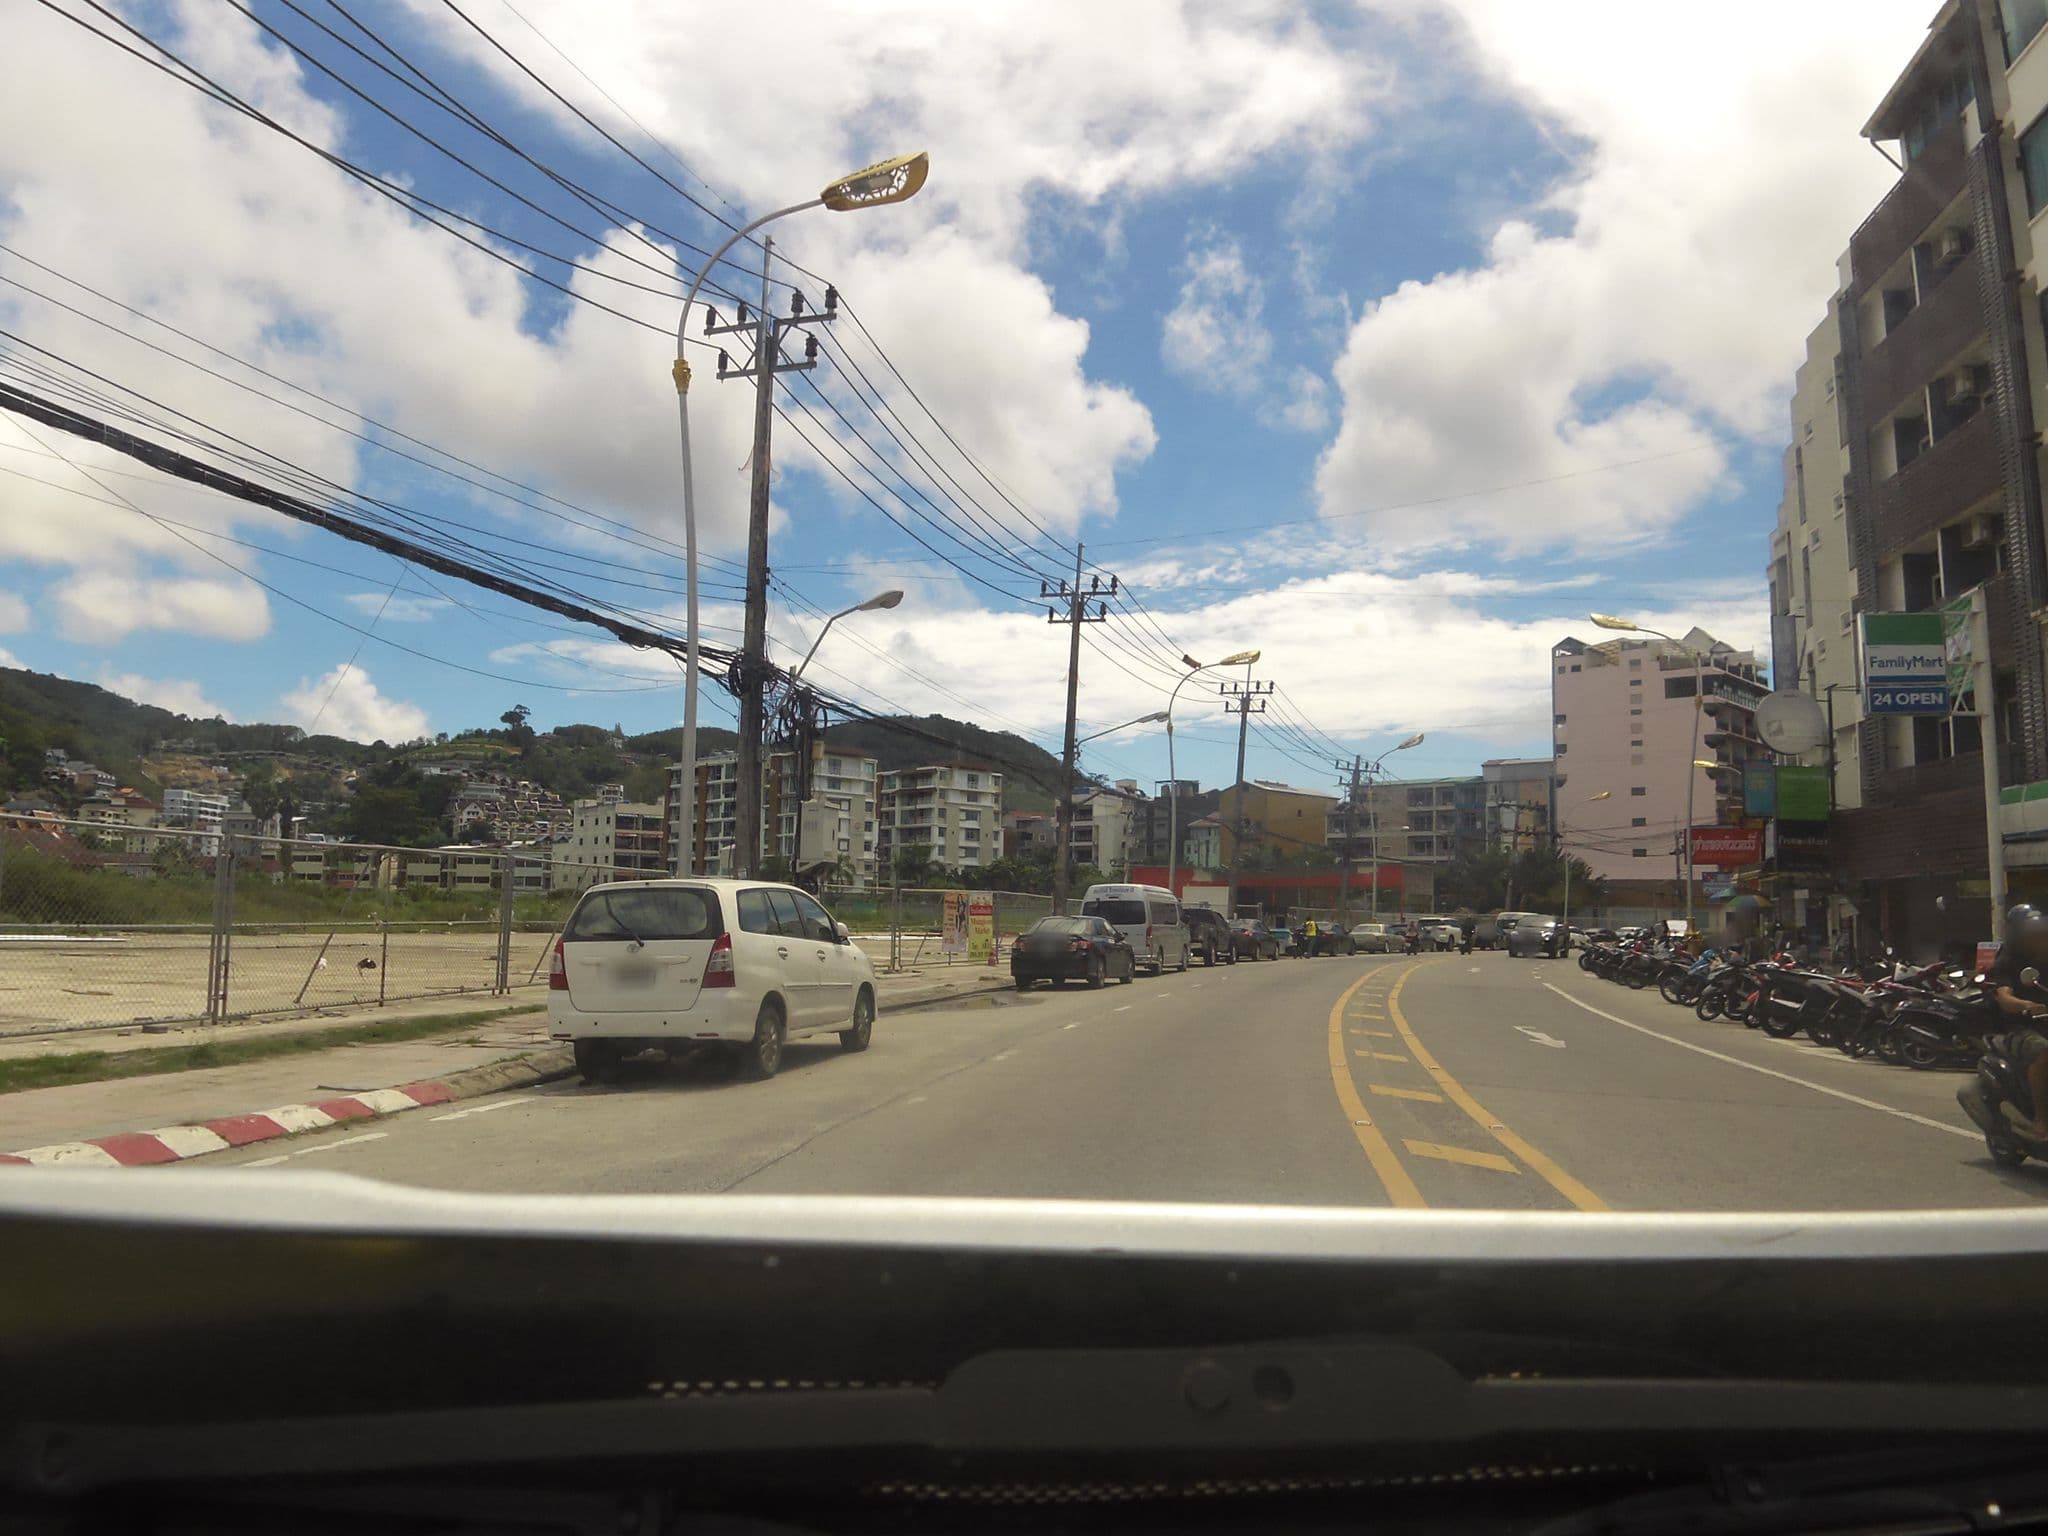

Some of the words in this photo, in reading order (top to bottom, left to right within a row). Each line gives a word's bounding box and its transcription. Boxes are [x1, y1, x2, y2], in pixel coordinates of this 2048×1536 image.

[1870, 655, 1944, 671] FamilyMart
[1872, 692, 1892, 706] 24
[1895, 692, 1944, 705] OPEN
